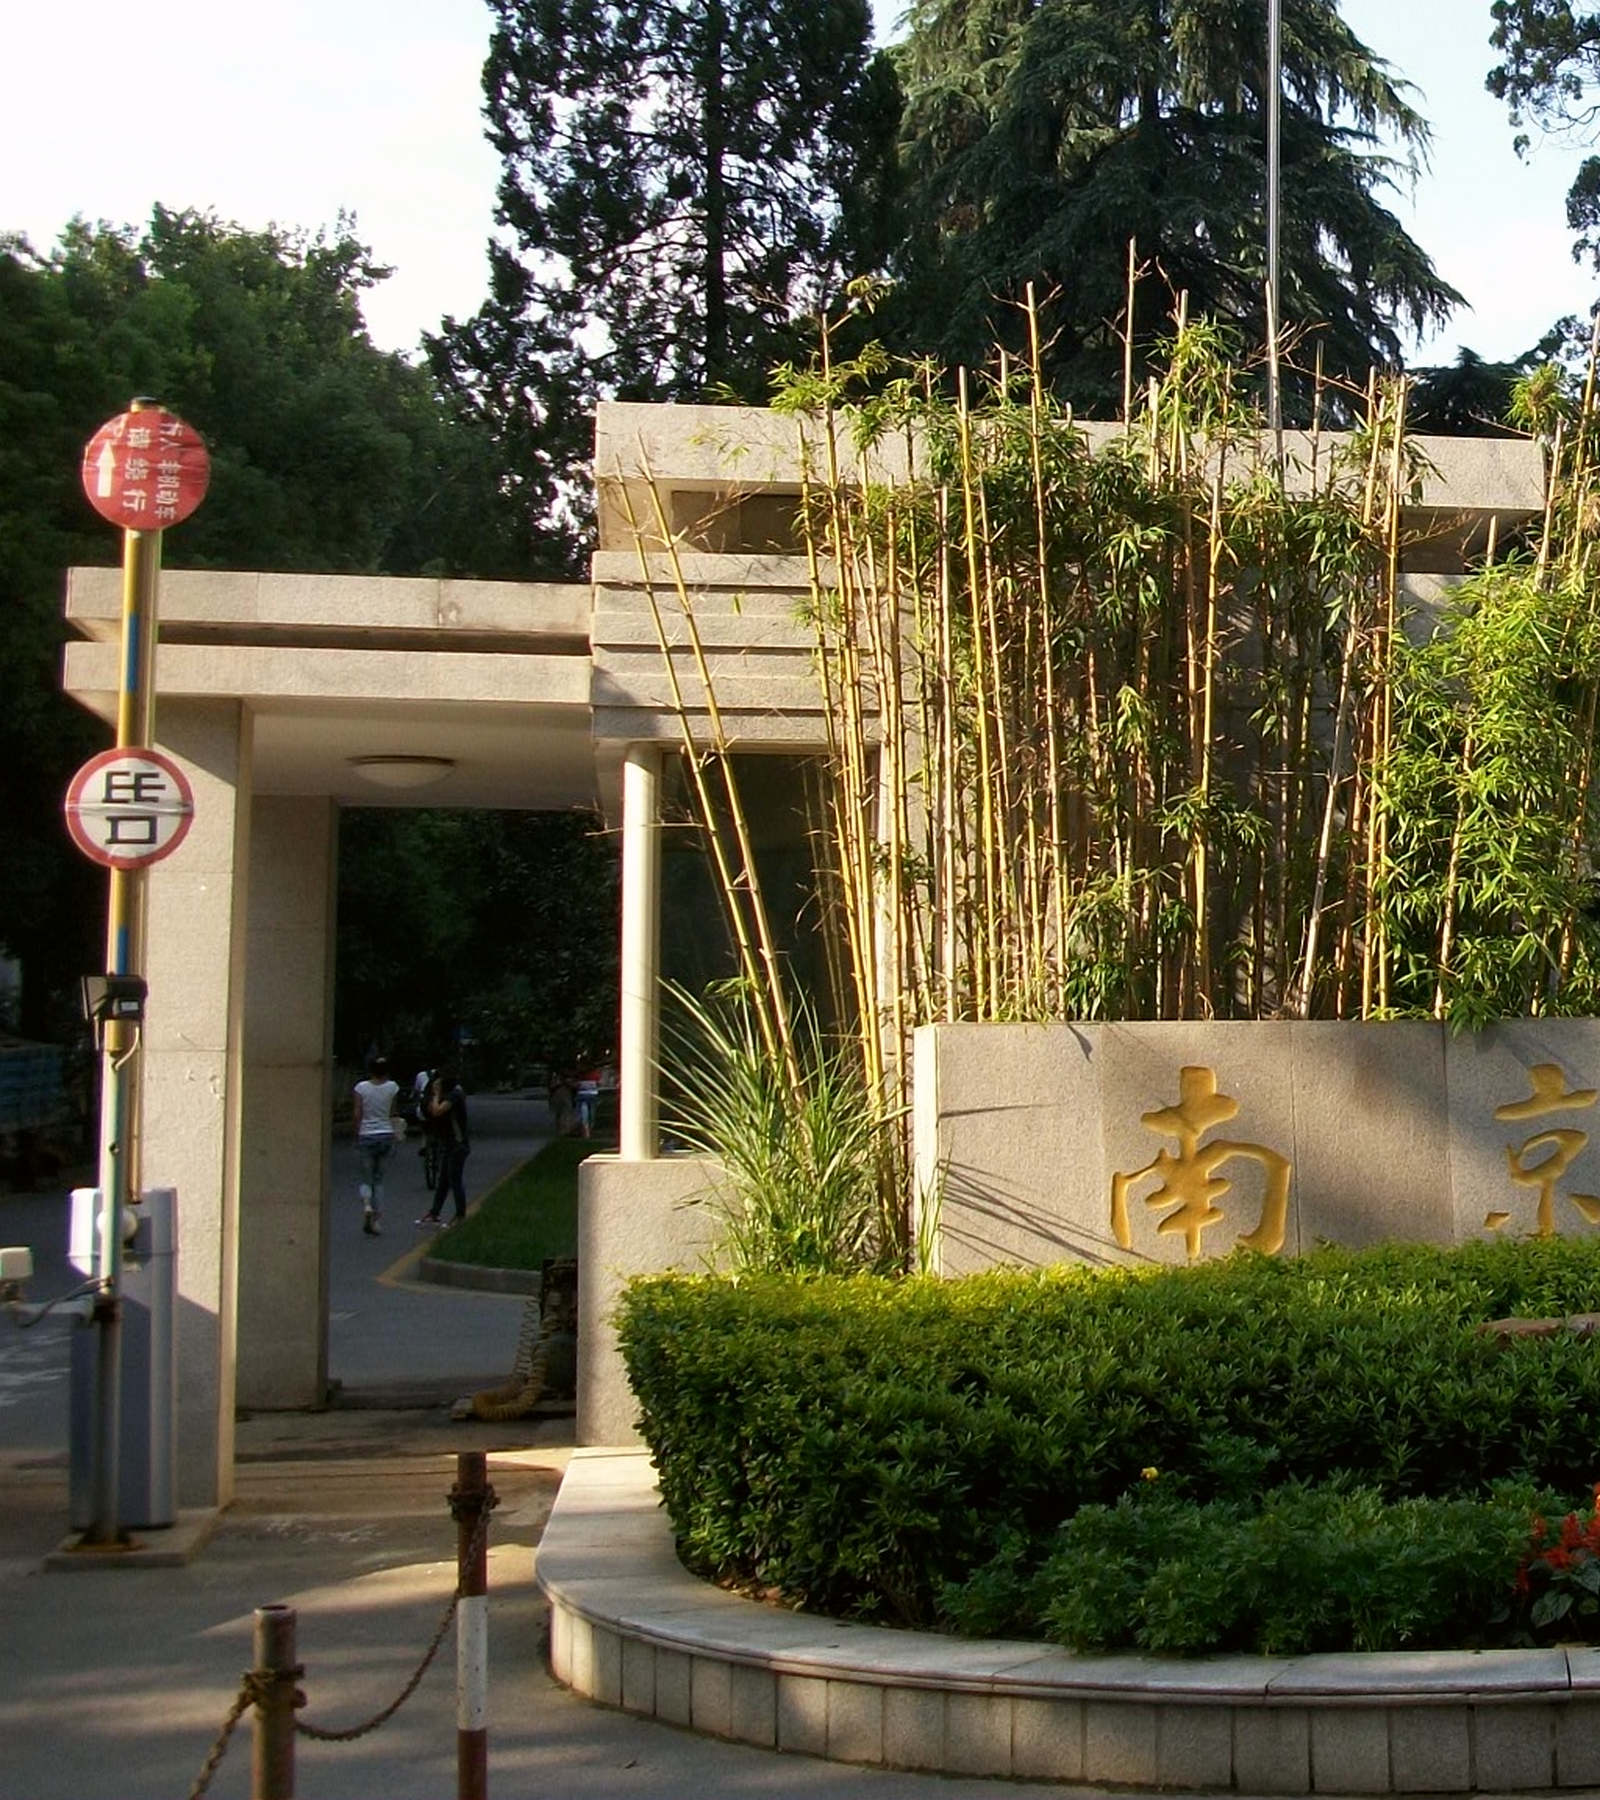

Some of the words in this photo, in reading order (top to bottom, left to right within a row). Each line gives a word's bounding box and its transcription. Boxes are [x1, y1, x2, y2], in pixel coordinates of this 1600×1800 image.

[159, 421, 184, 450] 行人
[123, 427, 150, 512] 请绕行
[154, 460, 182, 520] 非机动车
[102, 771, 166, 844] 出口
